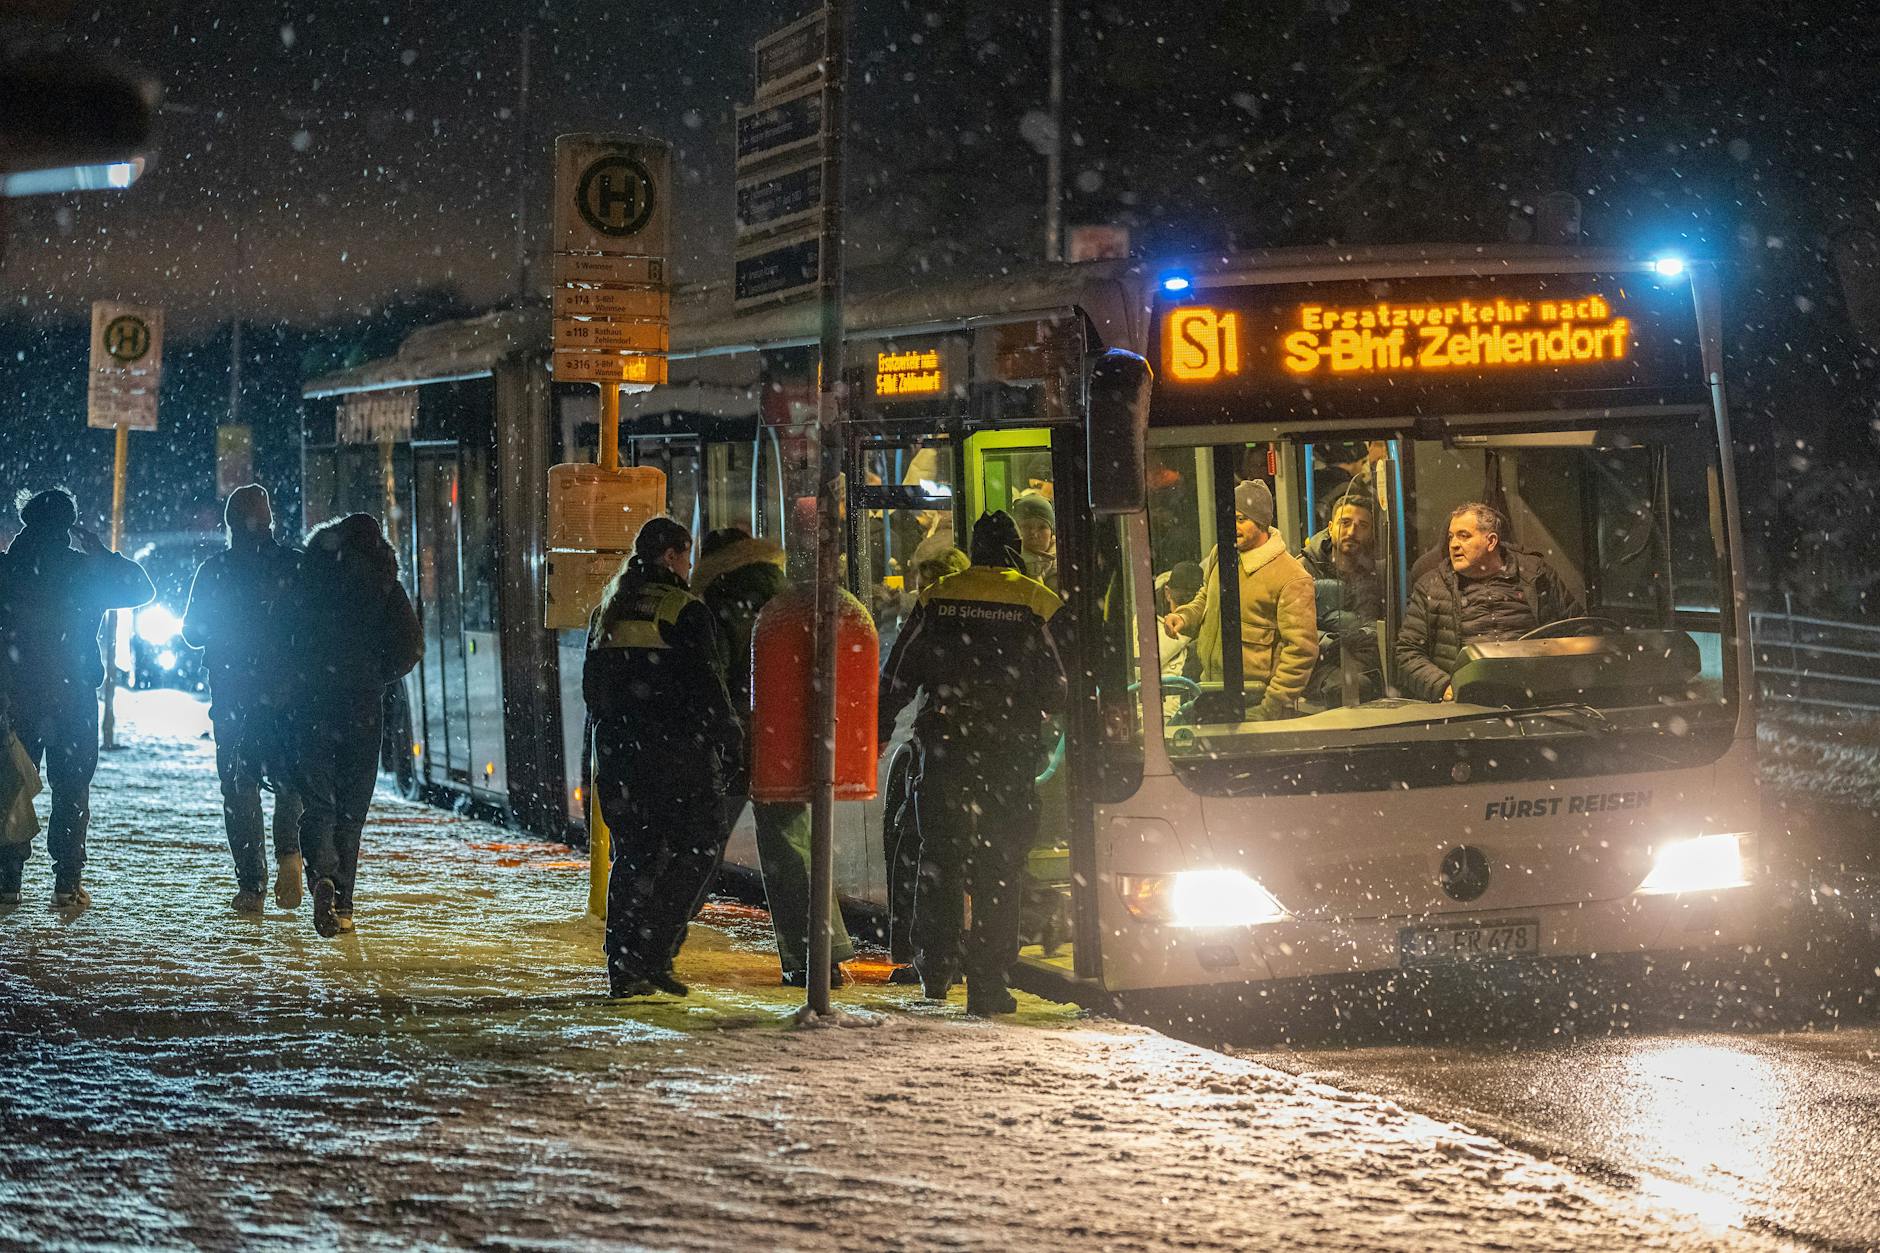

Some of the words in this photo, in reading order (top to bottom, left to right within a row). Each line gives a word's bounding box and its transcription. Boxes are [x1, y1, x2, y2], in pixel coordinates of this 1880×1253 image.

[598, 174, 636, 218] H
[582, 261, 614, 271] Wannsee
[573, 295, 590, 305] 114
[594, 304, 627, 313] Wannsee
[1301, 299, 1530, 331] Ersatzverkehr
[1540, 296, 1608, 322] nach
[117, 326, 140, 352] H
[573, 327, 590, 338] 118
[593, 327, 623, 337] Rathaus
[593, 336, 632, 345] Zehlendorf
[1169, 308, 1240, 380] S1
[1284, 327, 1413, 373] S-Bhf.
[1418, 318, 1628, 367] Zehlendorf
[573, 359, 590, 370] 316
[938, 604, 957, 616] DB
[959, 606, 1023, 622] Sicherheit
[1484, 796, 1563, 821] FÜRST
[1567, 790, 1654, 815] REISEN
[1487, 926, 1528, 951] 478
